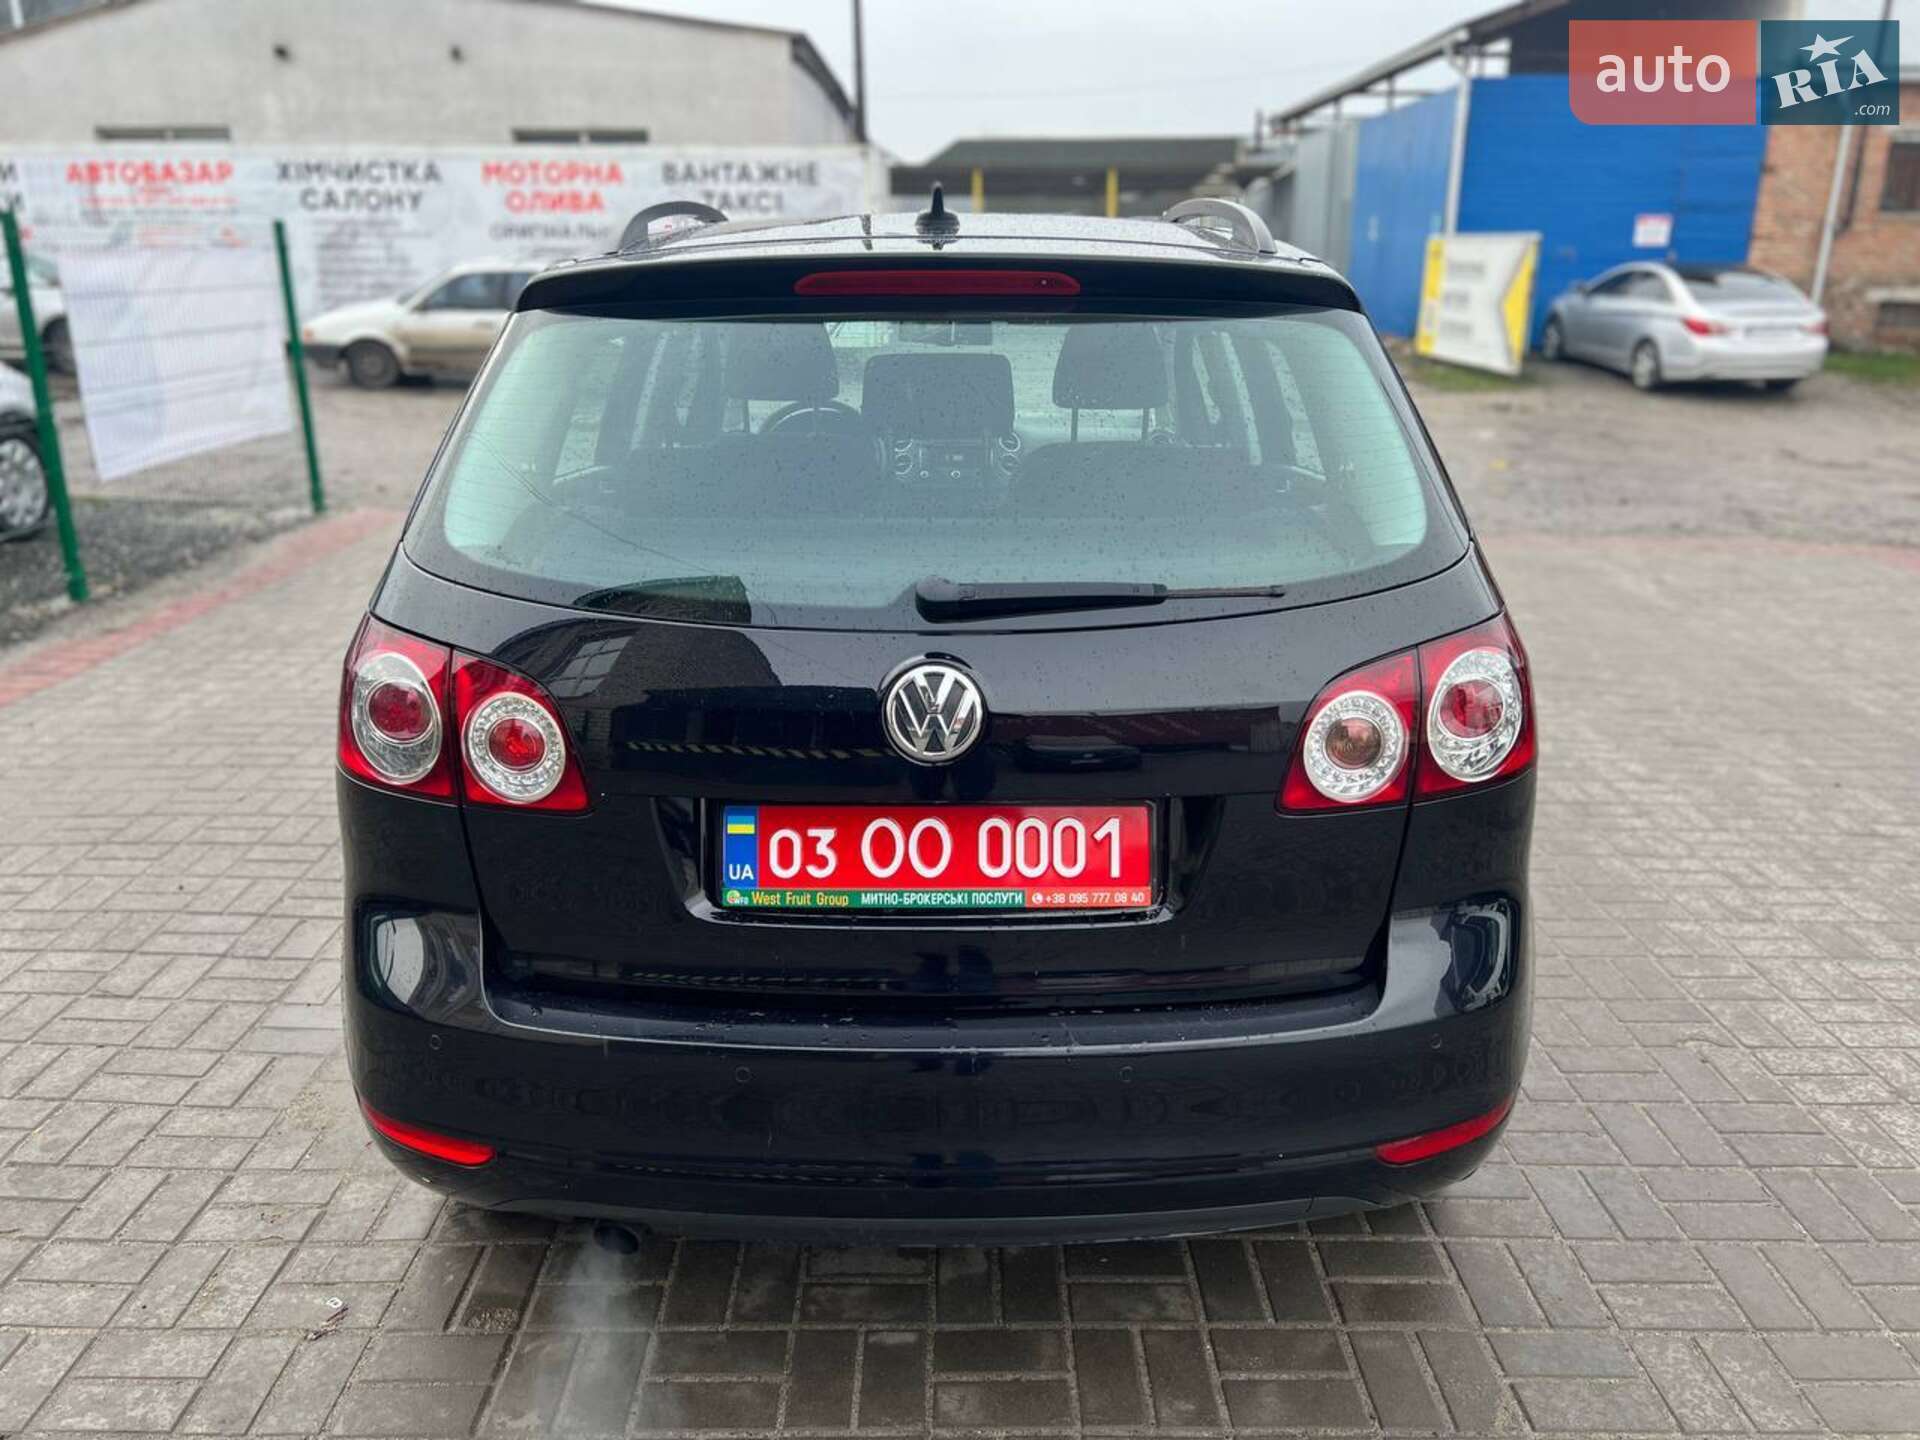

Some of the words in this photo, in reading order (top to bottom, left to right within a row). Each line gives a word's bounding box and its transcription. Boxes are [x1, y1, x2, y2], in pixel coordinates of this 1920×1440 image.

[66, 161, 234, 184] АВТОБАЗАР
[276, 161, 441, 182] ХІМЧИСТКА
[482, 161, 623, 184] МОТОРНА
[662, 162, 819, 185] ВАНТАЖНЕ
[300, 187, 421, 211] САЛОНУ
[505, 191, 605, 213] ОЛИВА
[703, 190, 784, 212] ТАКСІ
[769, 829, 837, 879] 03
[861, 817, 952, 879] OO
[977, 816, 1121, 879] 0001
[729, 864, 754, 880] UA
[751, 891, 781, 906] West
[785, 891, 811, 906] Fruit
[816, 891, 849, 907] Group
[861, 892, 968, 905] МИТНО-БРОКЕРСЬКІ
[971, 892, 1023, 905] ПОСЛУГИ
[1046, 892, 1066, 904] +38
[1092, 892, 1111, 903] 777
[1131, 891, 1145, 903] 40
